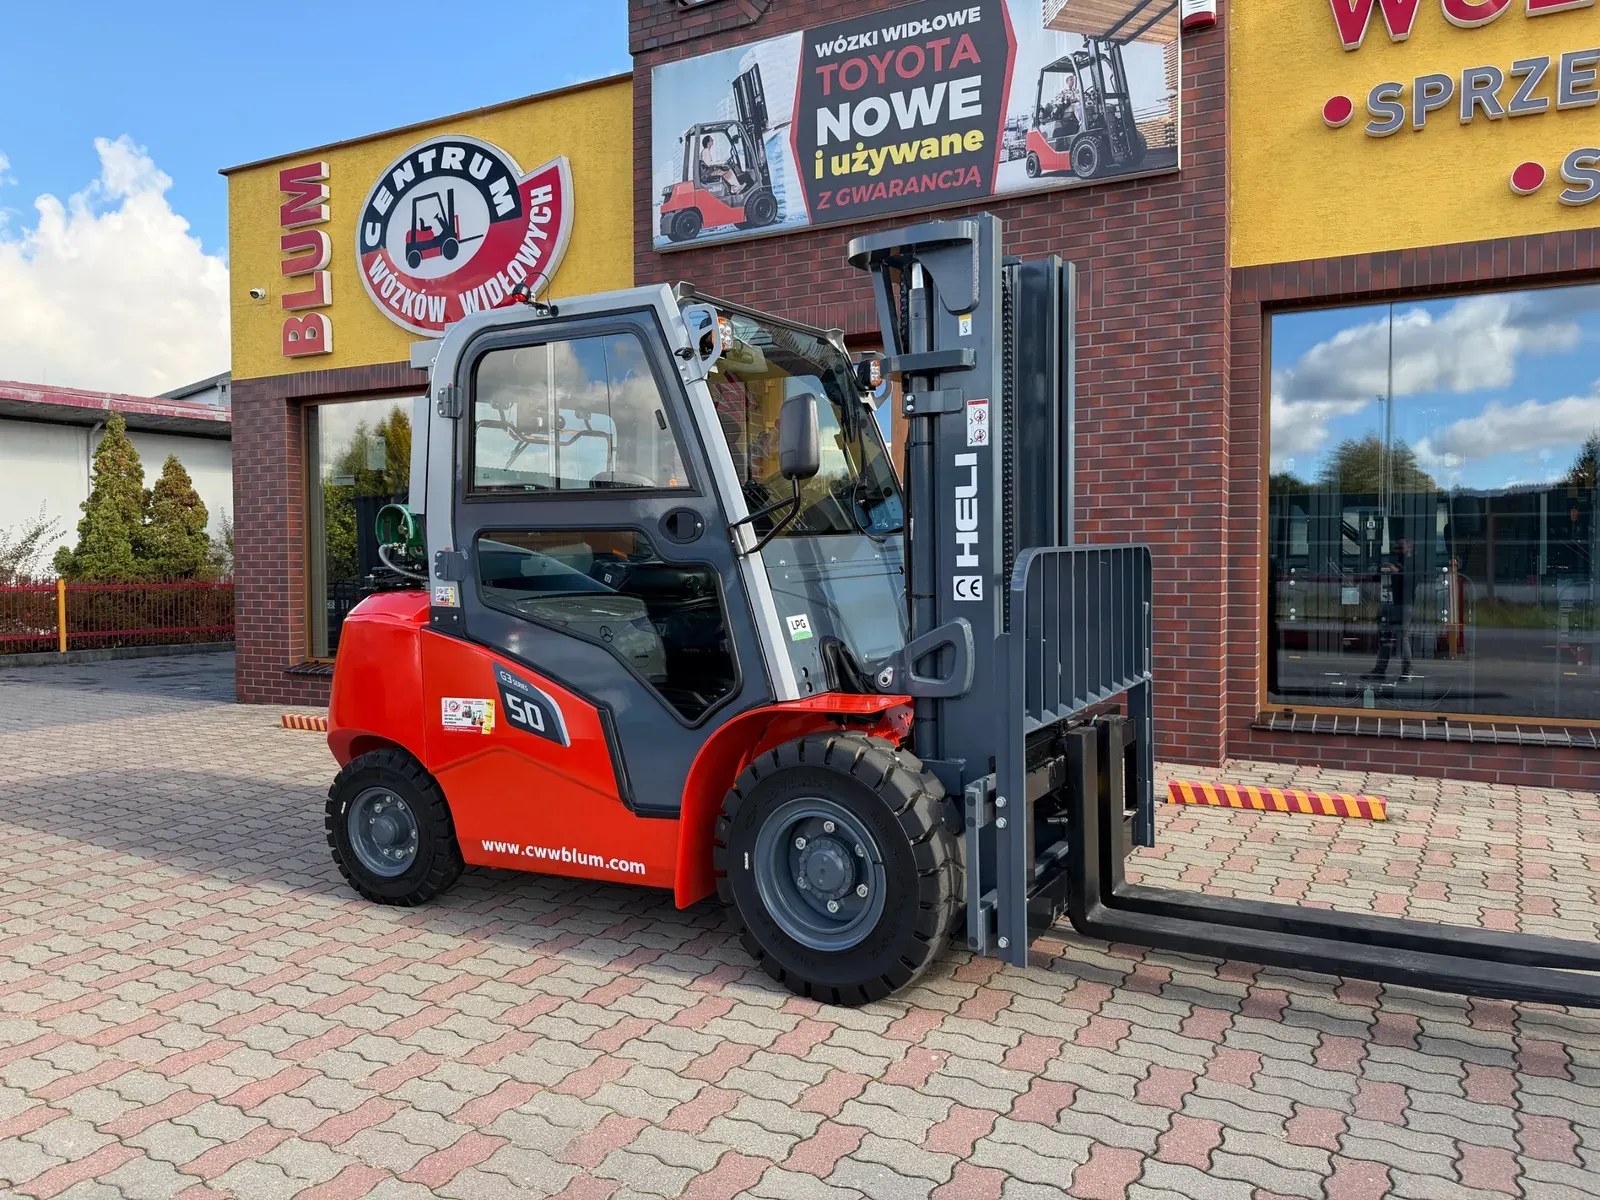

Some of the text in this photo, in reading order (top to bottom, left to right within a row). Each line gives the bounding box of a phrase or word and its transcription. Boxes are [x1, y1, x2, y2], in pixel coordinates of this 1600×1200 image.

[815, 6, 981, 58] WÓZKI WIDŁOWE
[815, 33, 982, 96] TOYOTA
[817, 75, 982, 147] NOWE
[815, 129, 985, 180] i używane
[365, 146, 516, 246] CENTRUM
[817, 165, 982, 210] Z GWARANCJĄ
[279, 161, 333, 358] BLUM
[368, 184, 553, 323] WÓZKÓW WIDŁOWYCH
[954, 452, 979, 567] HELI
[955, 578, 981, 598] CE
[791, 618, 807, 630] LPG
[500, 670, 513, 684] G3
[505, 692, 545, 732] 50
[481, 839, 646, 875] www.cwwblum.com
